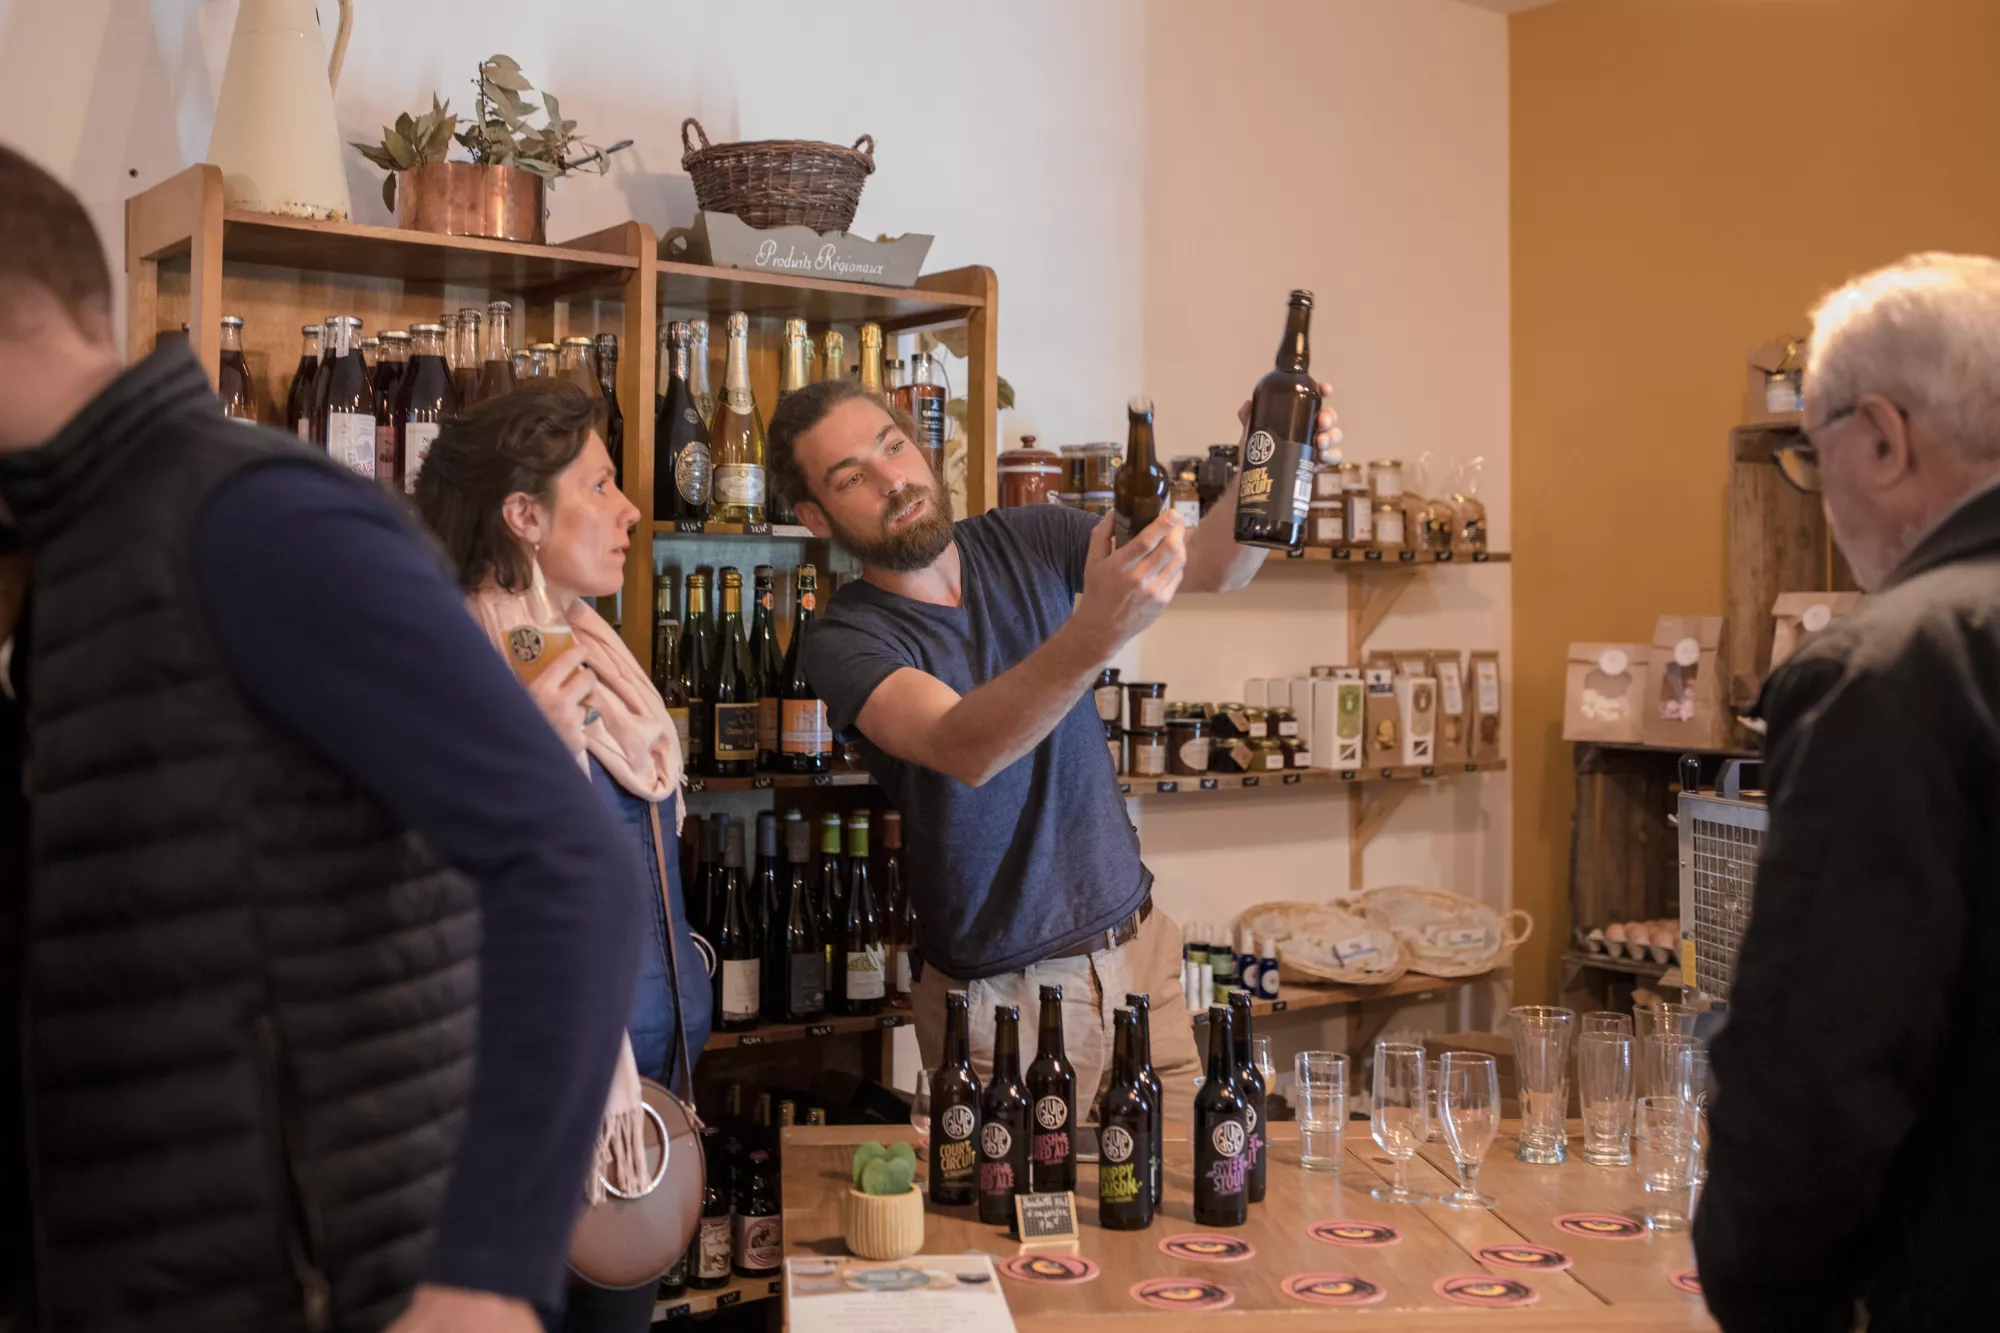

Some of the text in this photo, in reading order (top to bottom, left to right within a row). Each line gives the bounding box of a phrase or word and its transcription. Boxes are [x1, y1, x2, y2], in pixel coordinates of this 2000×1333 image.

[755, 239, 884, 275] Produits Régionaux
[1240, 479, 1273, 497] CIRCUIT
[940, 1140, 972, 1158] COURT
[1054, 1141, 1069, 1158] ALE
[941, 1150, 976, 1171] CIRCUIT
[1213, 1169, 1244, 1192] STOUT
